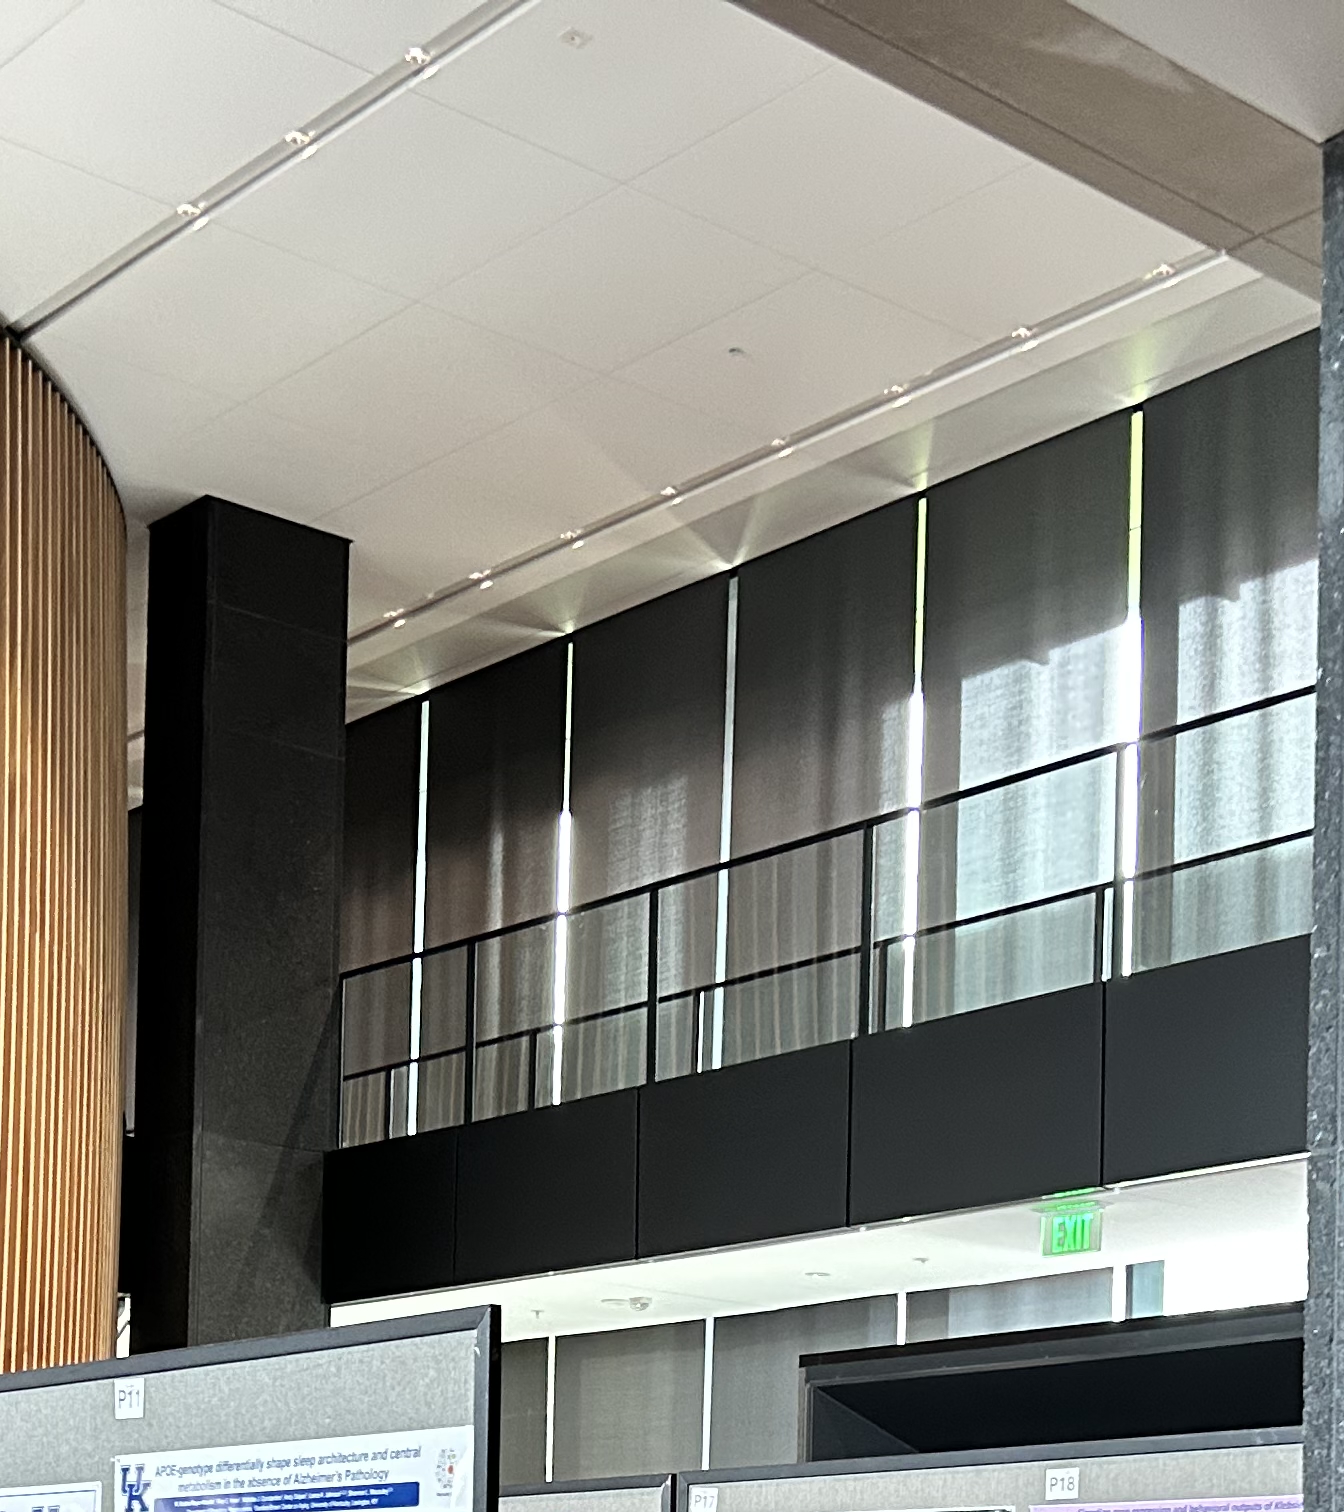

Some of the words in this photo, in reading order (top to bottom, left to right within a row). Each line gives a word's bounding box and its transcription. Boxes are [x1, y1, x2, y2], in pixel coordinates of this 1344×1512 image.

[1051, 1213, 1094, 1254] EXIT
[118, 1389, 140, 1409] P11
[266, 1457, 291, 1470] shape
[293, 1455, 316, 1468] sleep
[317, 1452, 369, 1465] architecture
[370, 1448, 389, 1461] and
[390, 1446, 421, 1460] central
[233, 1478, 245, 1488] the
[283, 1474, 293, 1485] of
[344, 1469, 390, 1482] Pathology
[1050, 1476, 1075, 1492] P18
[694, 1494, 715, 1509] P17
